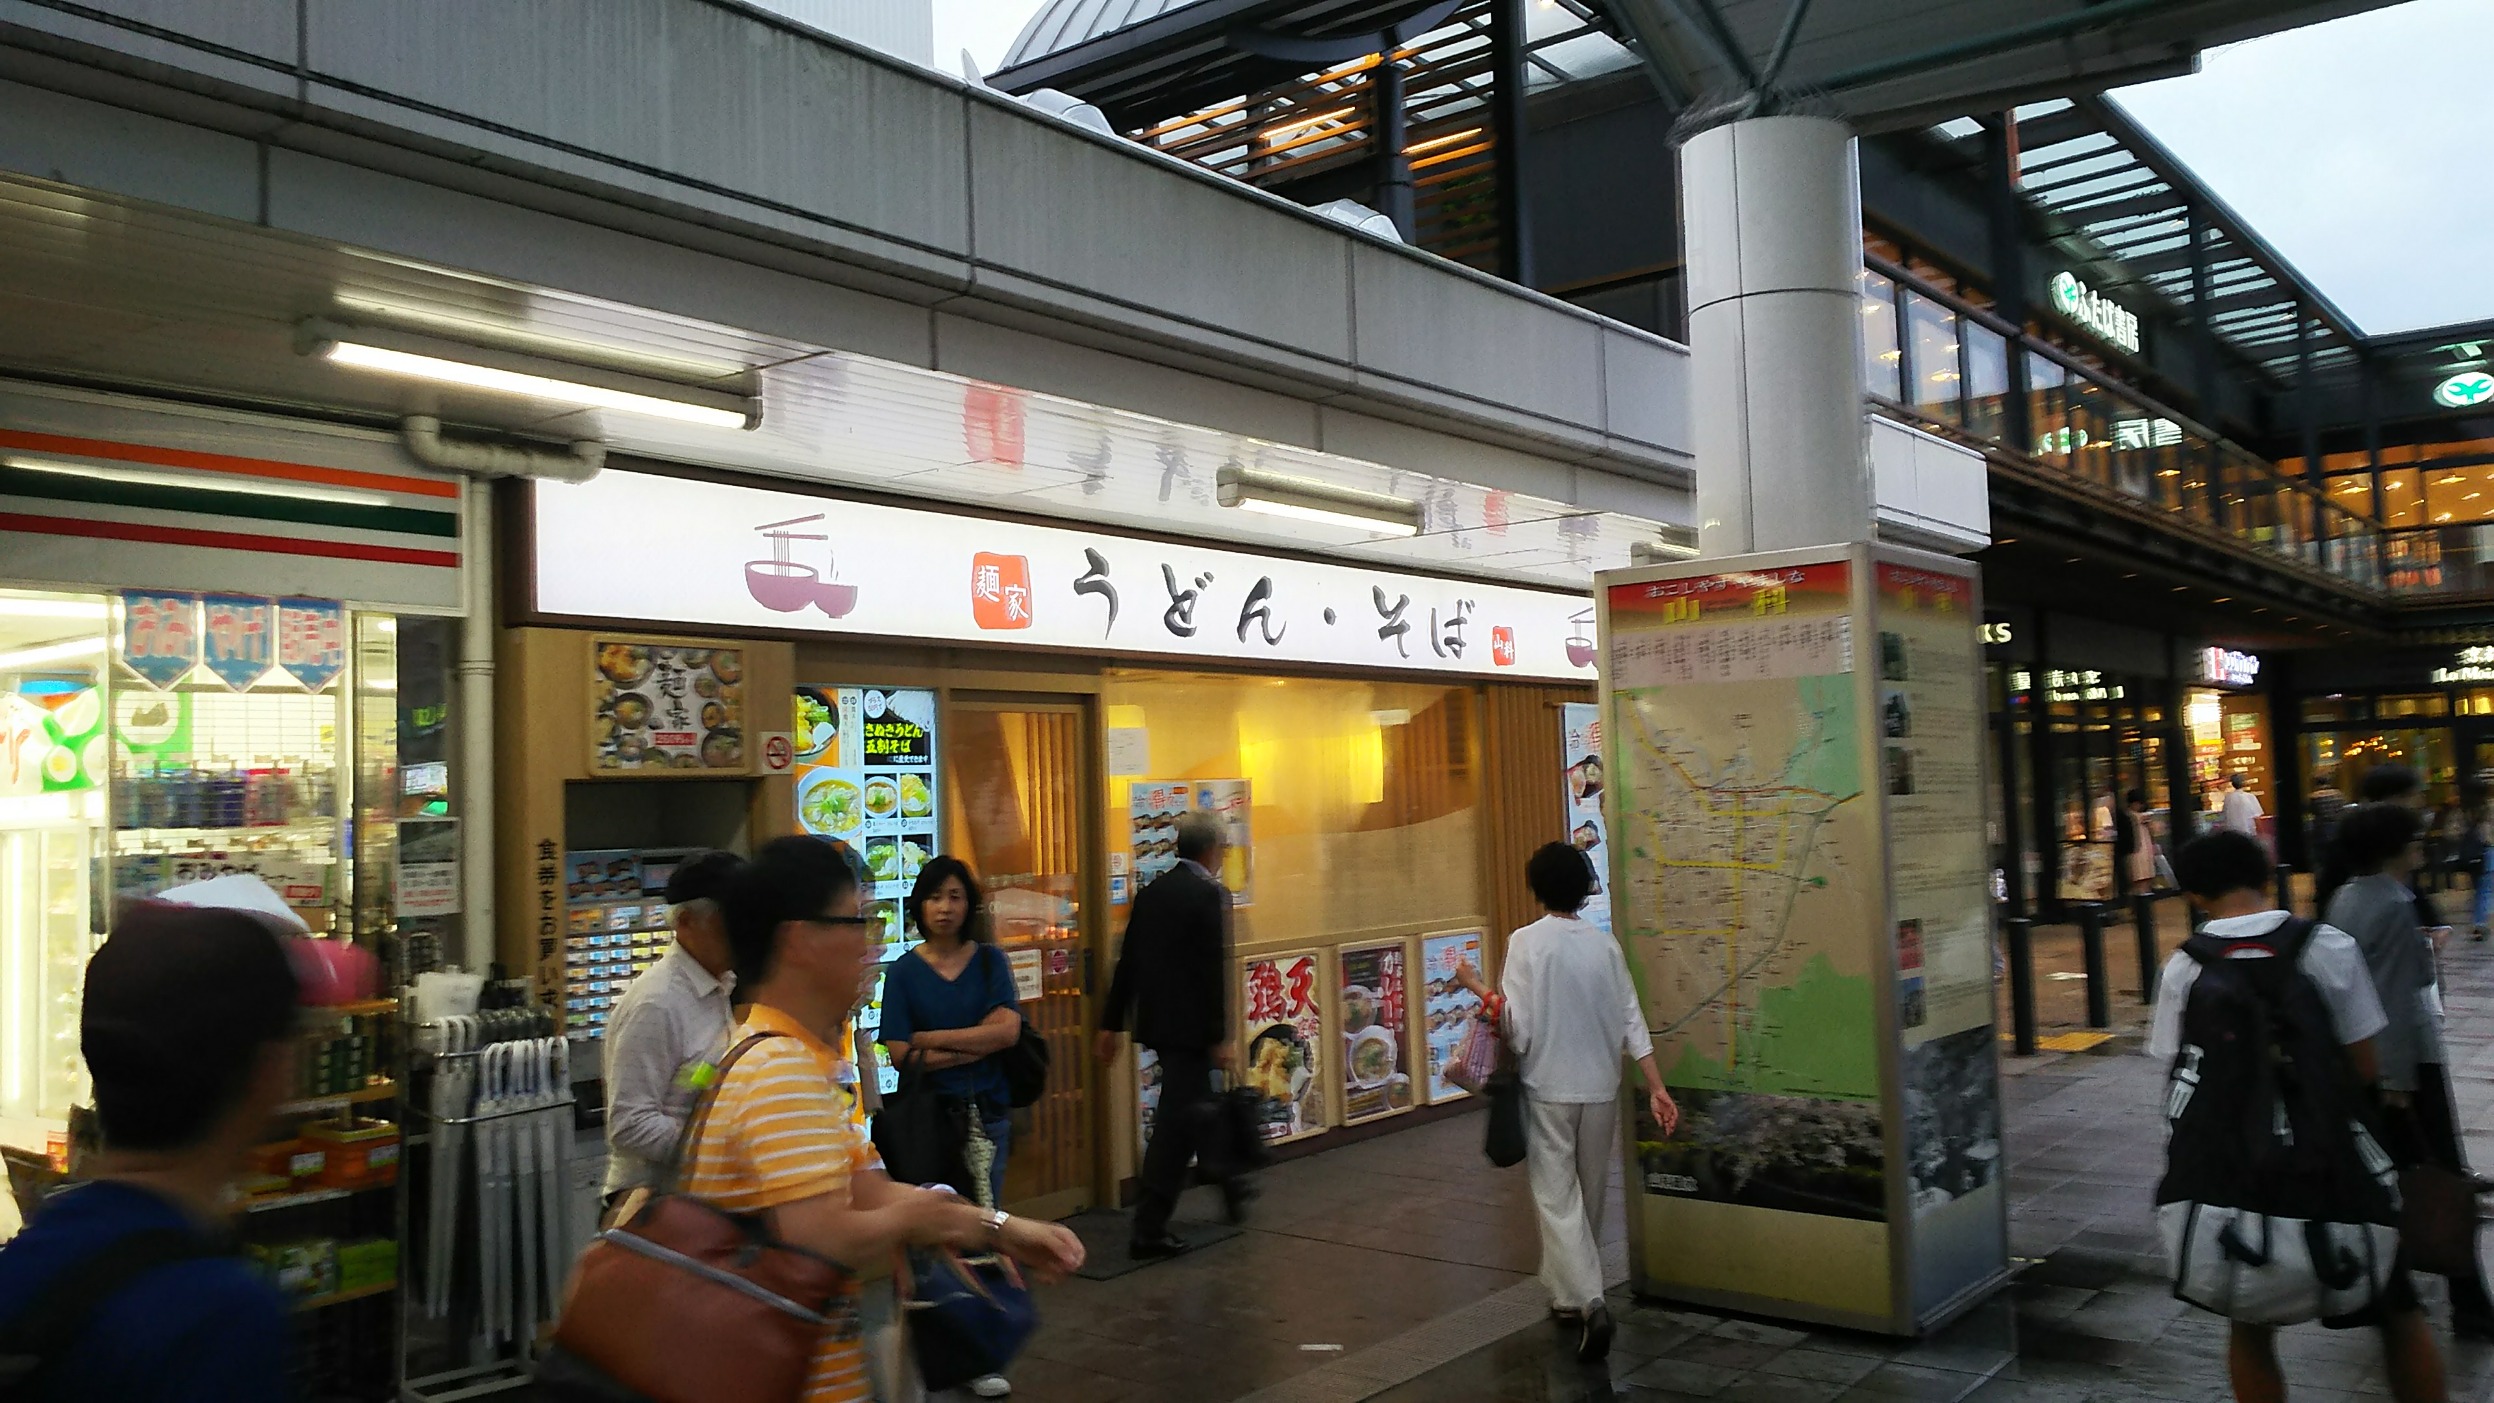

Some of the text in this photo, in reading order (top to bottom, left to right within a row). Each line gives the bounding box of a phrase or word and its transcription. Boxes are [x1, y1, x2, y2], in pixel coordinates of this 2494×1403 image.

[2077, 281, 2140, 352] ふたば書房
[976, 564, 1030, 621] 麺家
[1073, 546, 1476, 659] うどん・そば
[1493, 633, 1515, 660] 山科
[865, 722, 923, 738] さぬきうどん
[865, 739, 911, 754] 五割そば
